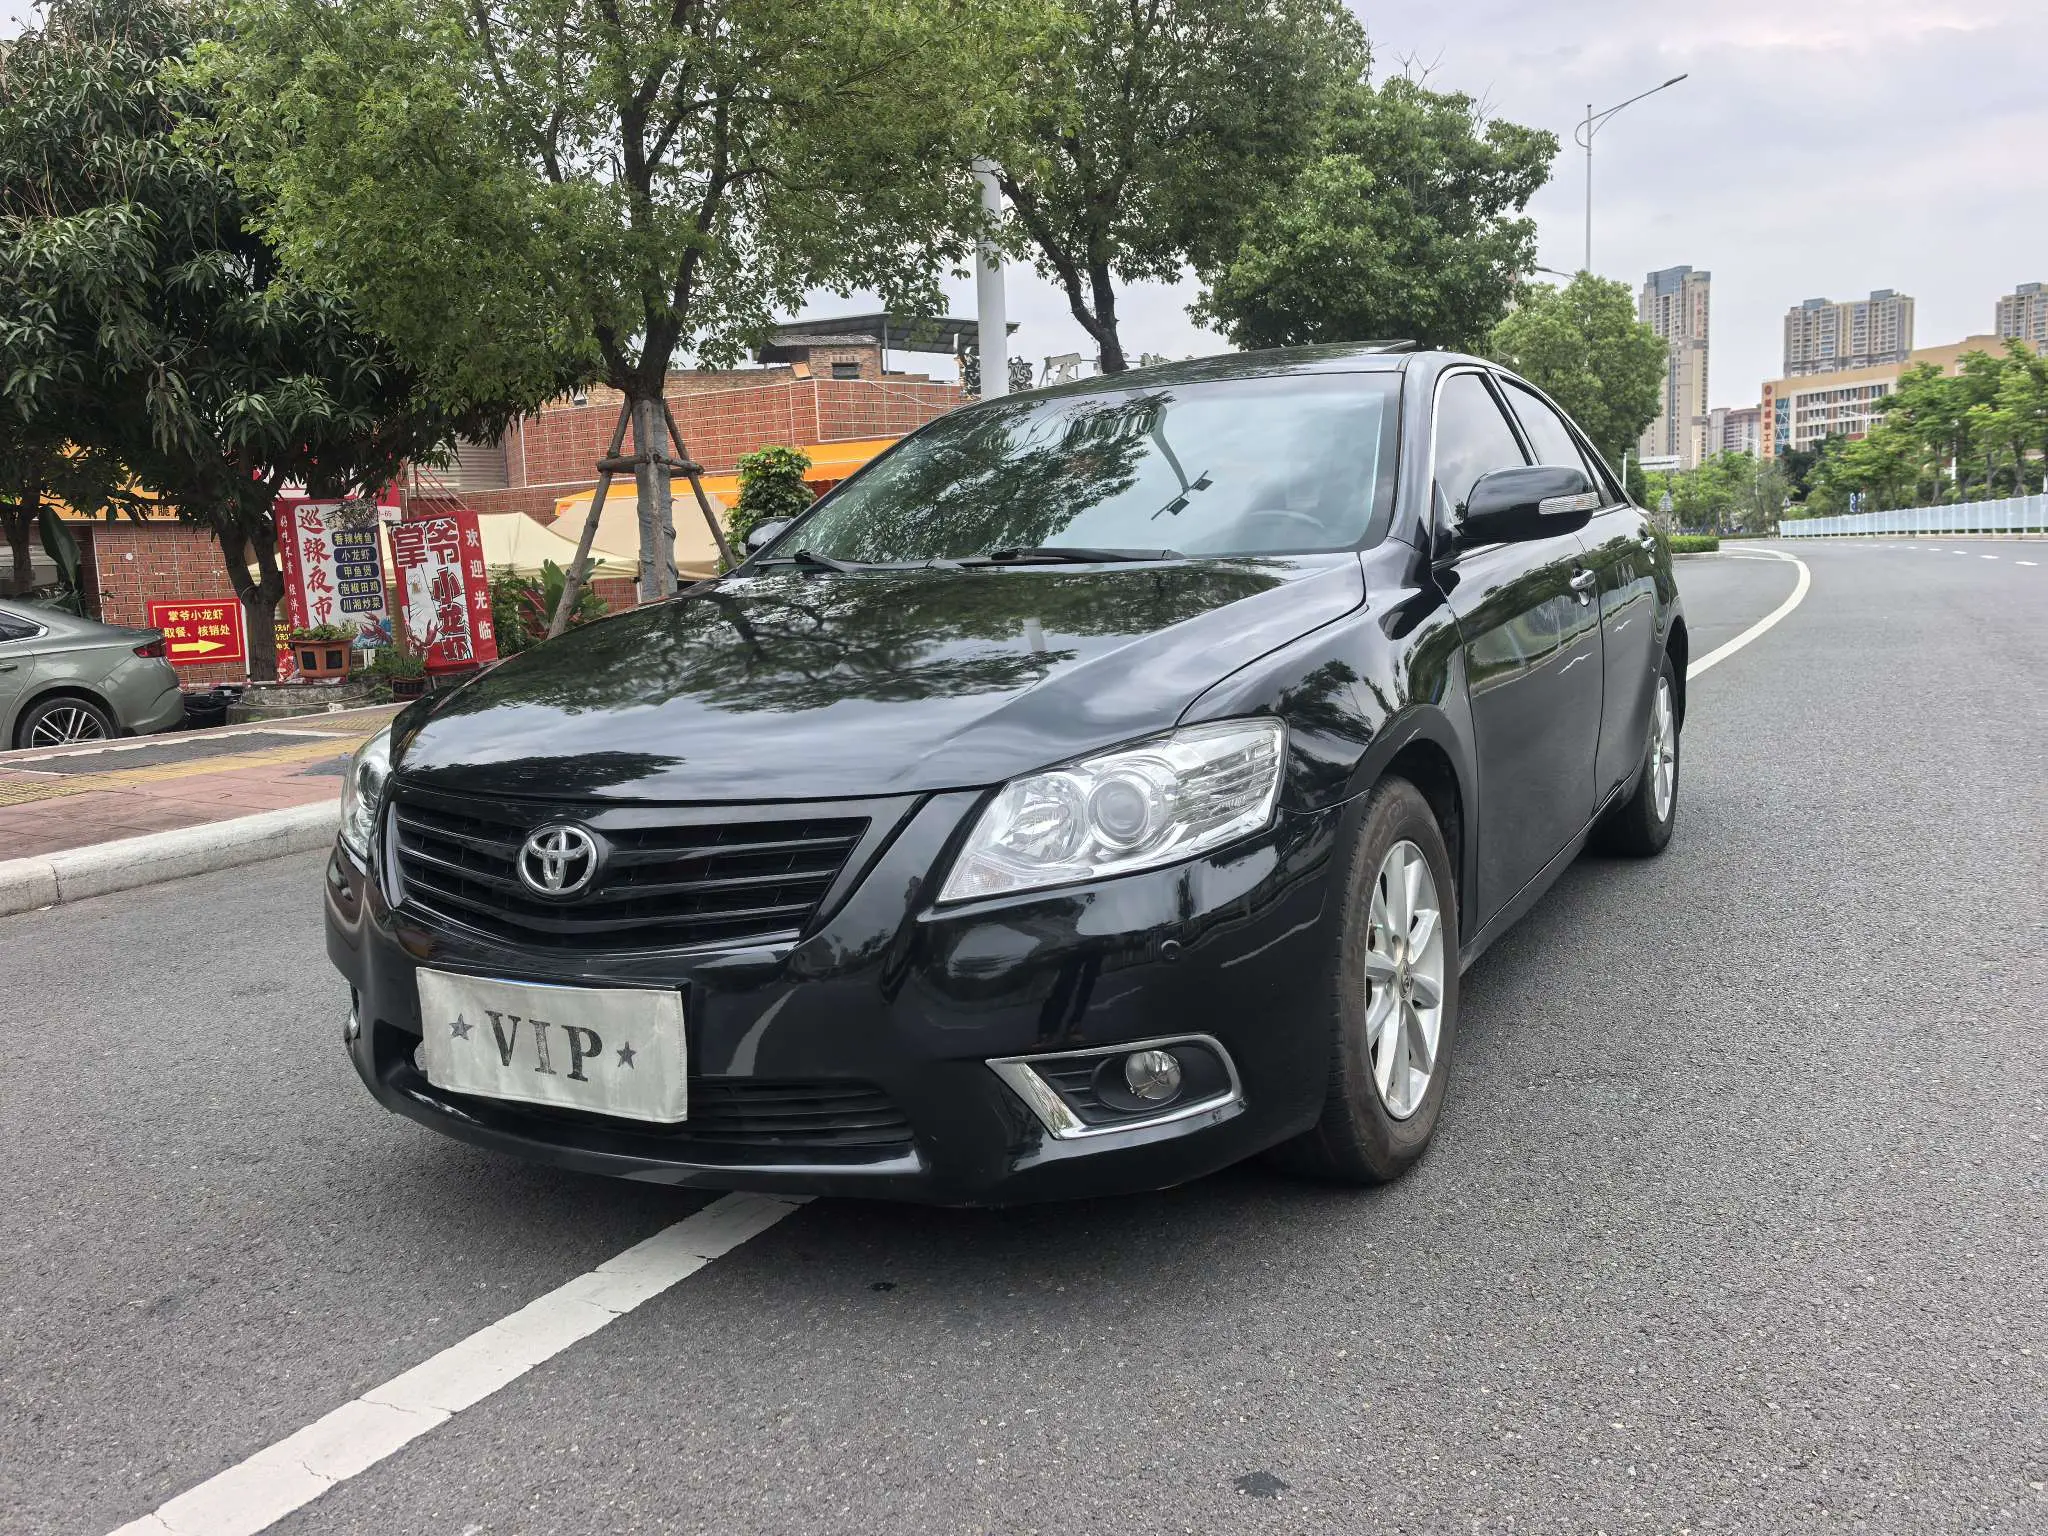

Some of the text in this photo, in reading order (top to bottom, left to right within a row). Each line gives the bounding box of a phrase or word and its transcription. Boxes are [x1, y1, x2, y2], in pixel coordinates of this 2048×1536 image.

[335, 532, 373, 546] 香辣烤鱼
[341, 548, 370, 562] 小龙虾
[297, 505, 335, 625] 巡辣夜市
[343, 564, 373, 578] 甲鱼煲
[340, 580, 379, 597] 泡椒田鸡
[466, 528, 493, 641] 欢迎光临
[343, 596, 381, 612] 川湘炒菜
[168, 609, 224, 622] 掌爷小龙虾
[485, 1010, 603, 1082] VIP
